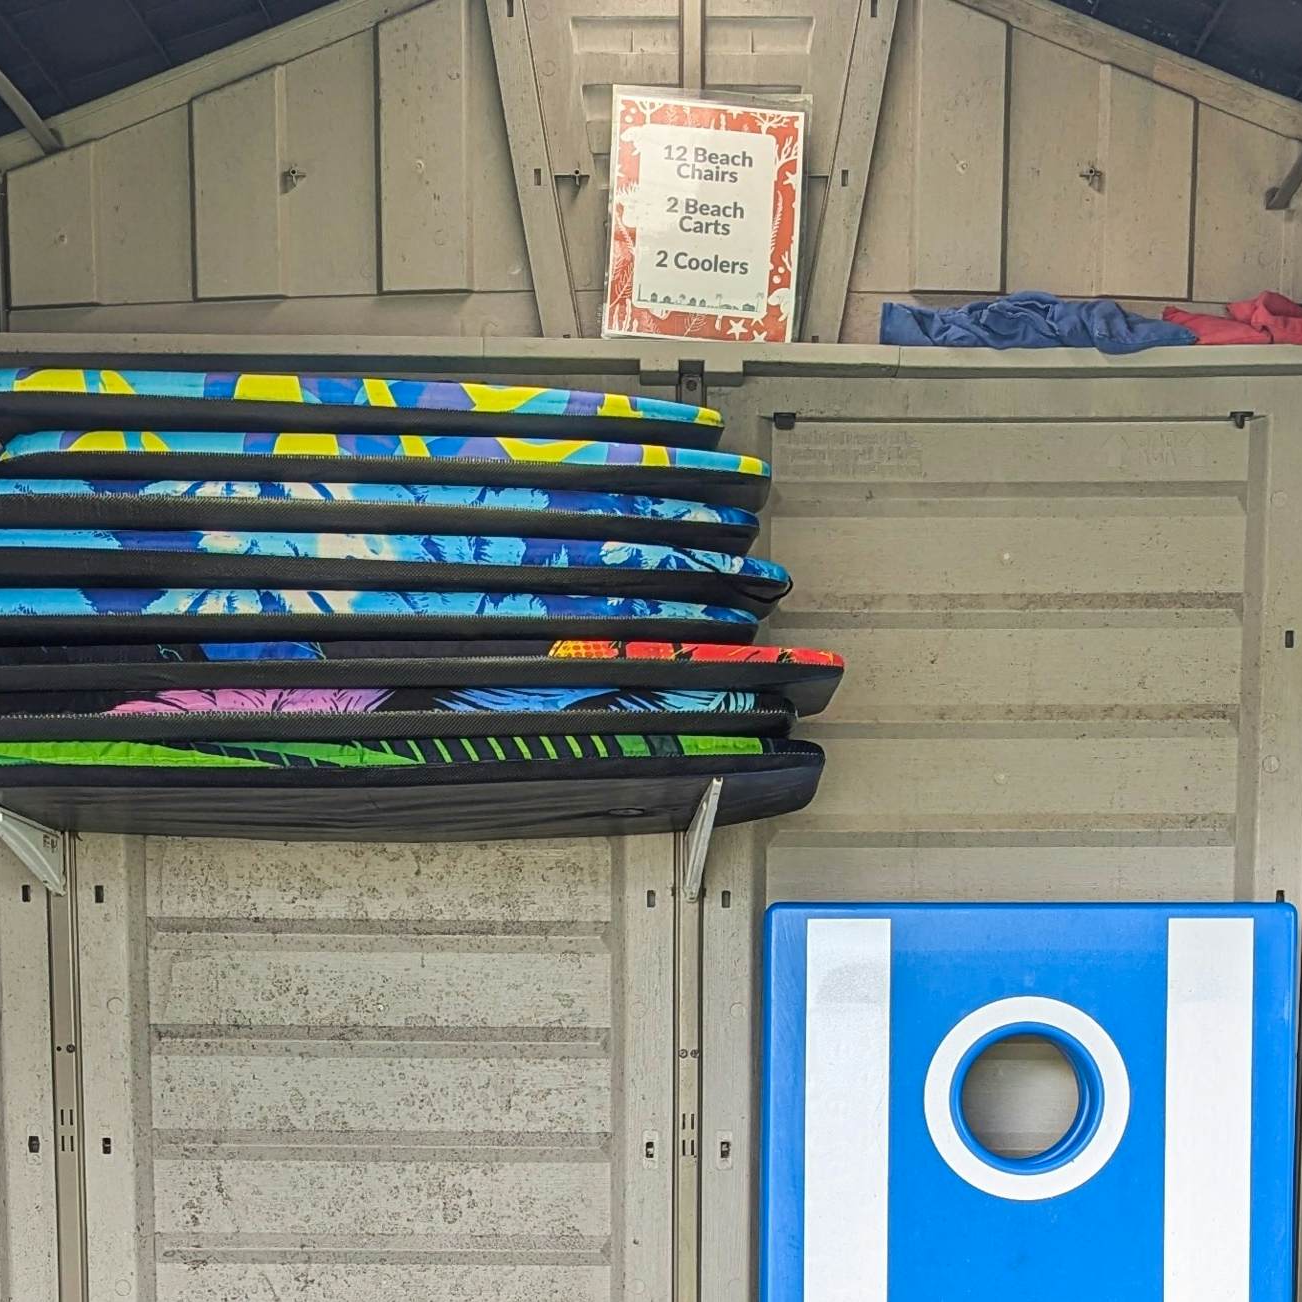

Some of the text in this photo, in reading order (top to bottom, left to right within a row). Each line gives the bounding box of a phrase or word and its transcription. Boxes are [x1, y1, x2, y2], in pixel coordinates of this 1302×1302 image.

[664, 145, 753, 168] 12 Beach
[676, 163, 738, 183] Chairs
[666, 197, 745, 219] 2 Beach
[678, 215, 731, 236] Carts
[655, 250, 749, 275] 2 Coolers
